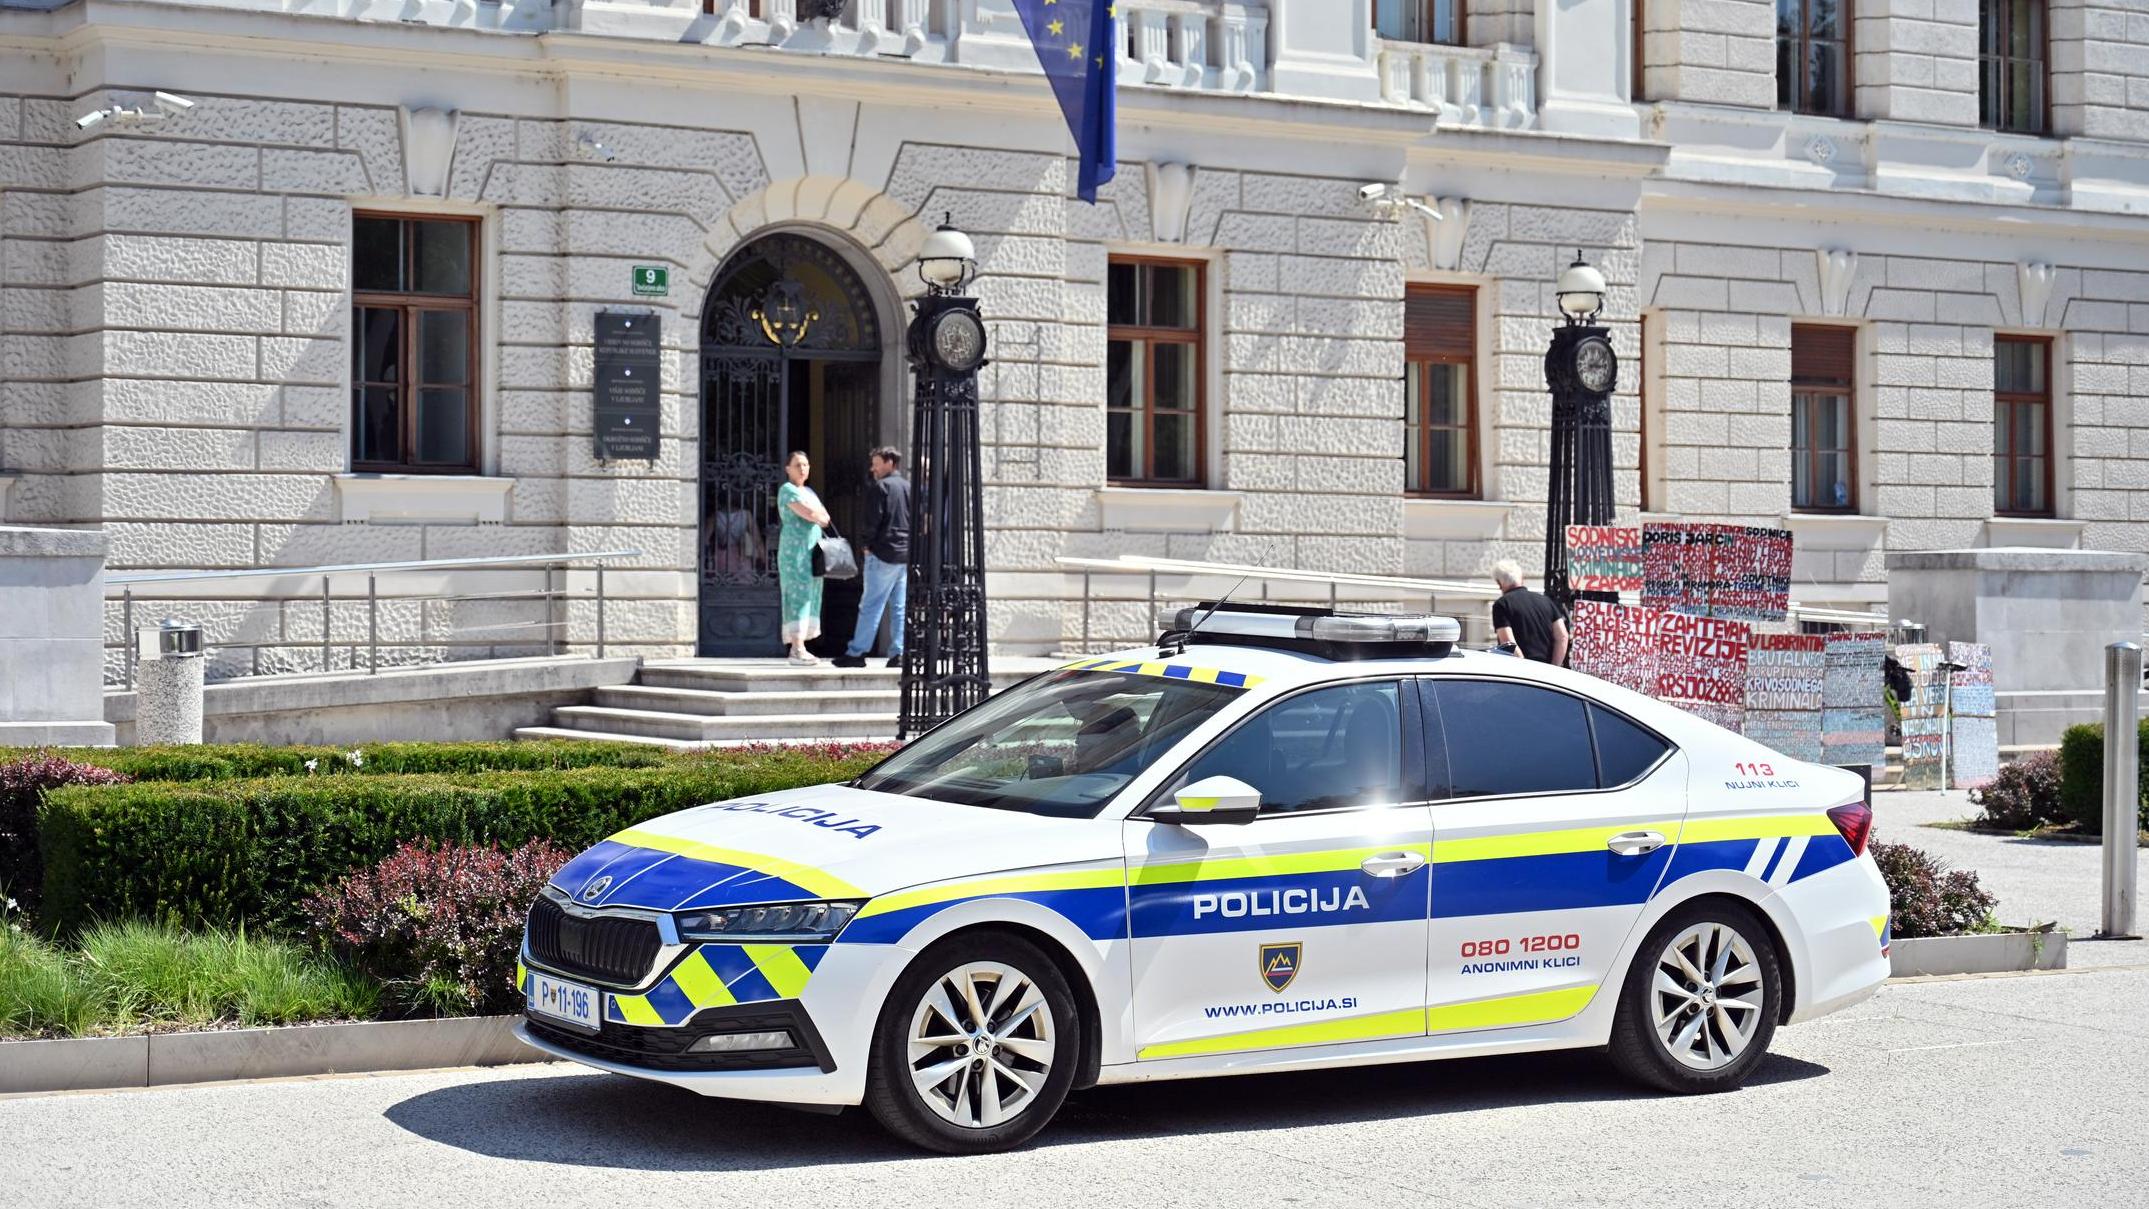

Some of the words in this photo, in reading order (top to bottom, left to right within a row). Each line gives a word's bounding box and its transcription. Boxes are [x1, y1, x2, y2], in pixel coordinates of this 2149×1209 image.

[646, 270, 656, 283] 9
[1643, 531, 1681, 545] DORIS
[1745, 526, 1793, 540] SODNICE
[1662, 612, 1751, 641] ZAHTEVAM
[1659, 634, 1748, 663] REVIZIJE
[1746, 677, 1823, 693] KRIVOSODNEGA
[1746, 691, 1822, 710] KRIMINALA
[1735, 762, 1774, 777] 113
[1725, 780, 1765, 790] NUJNI
[1768, 779, 1800, 789] KLICI
[1193, 885, 1370, 920] POLICIJA
[1460, 938, 1511, 958] 080
[1519, 933, 1581, 952] 1200
[1460, 959, 1539, 975] ANONIMNI
[1543, 956, 1581, 968] KLICI
[542, 980, 550, 1007] P
[557, 985, 589, 1019] 11-196
[1204, 997, 1358, 1018] WWW.POLICIJA.SI
